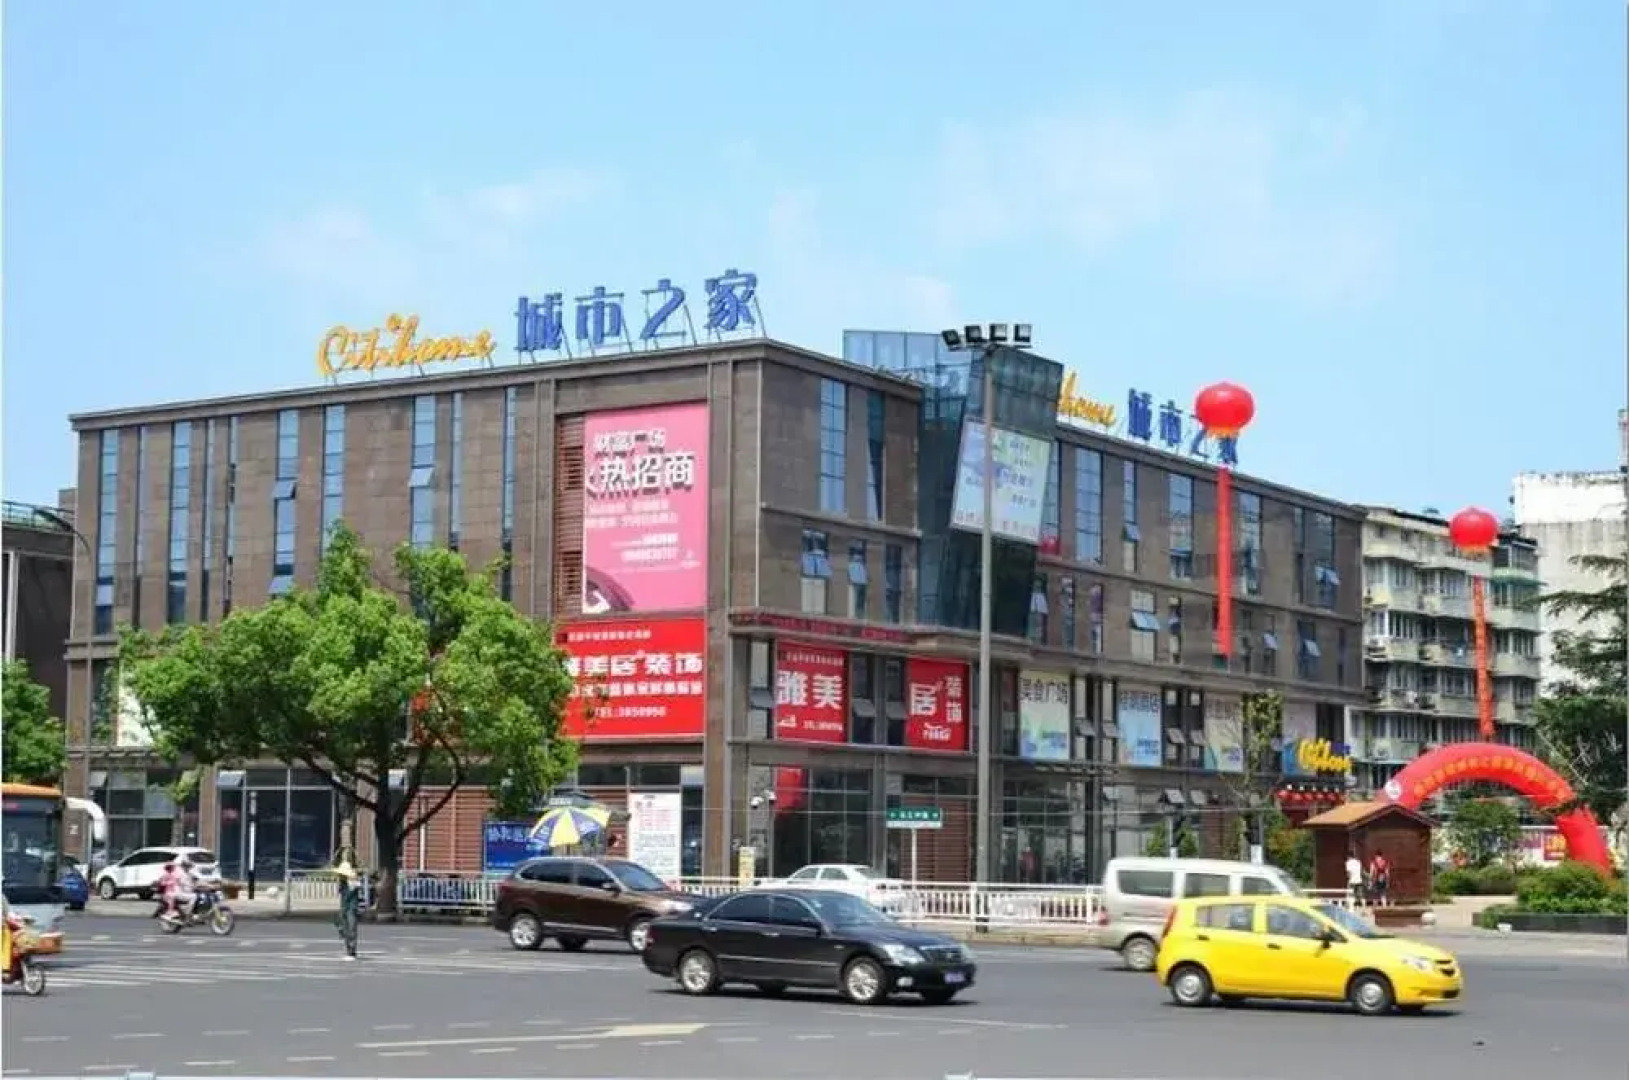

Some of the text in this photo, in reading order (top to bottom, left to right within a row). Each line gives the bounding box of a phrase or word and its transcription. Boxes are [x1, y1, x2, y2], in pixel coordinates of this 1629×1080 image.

[514, 269, 757, 352] 城市之家
[776, 670, 842, 710] 雅美
[909, 683, 937, 716] 居
